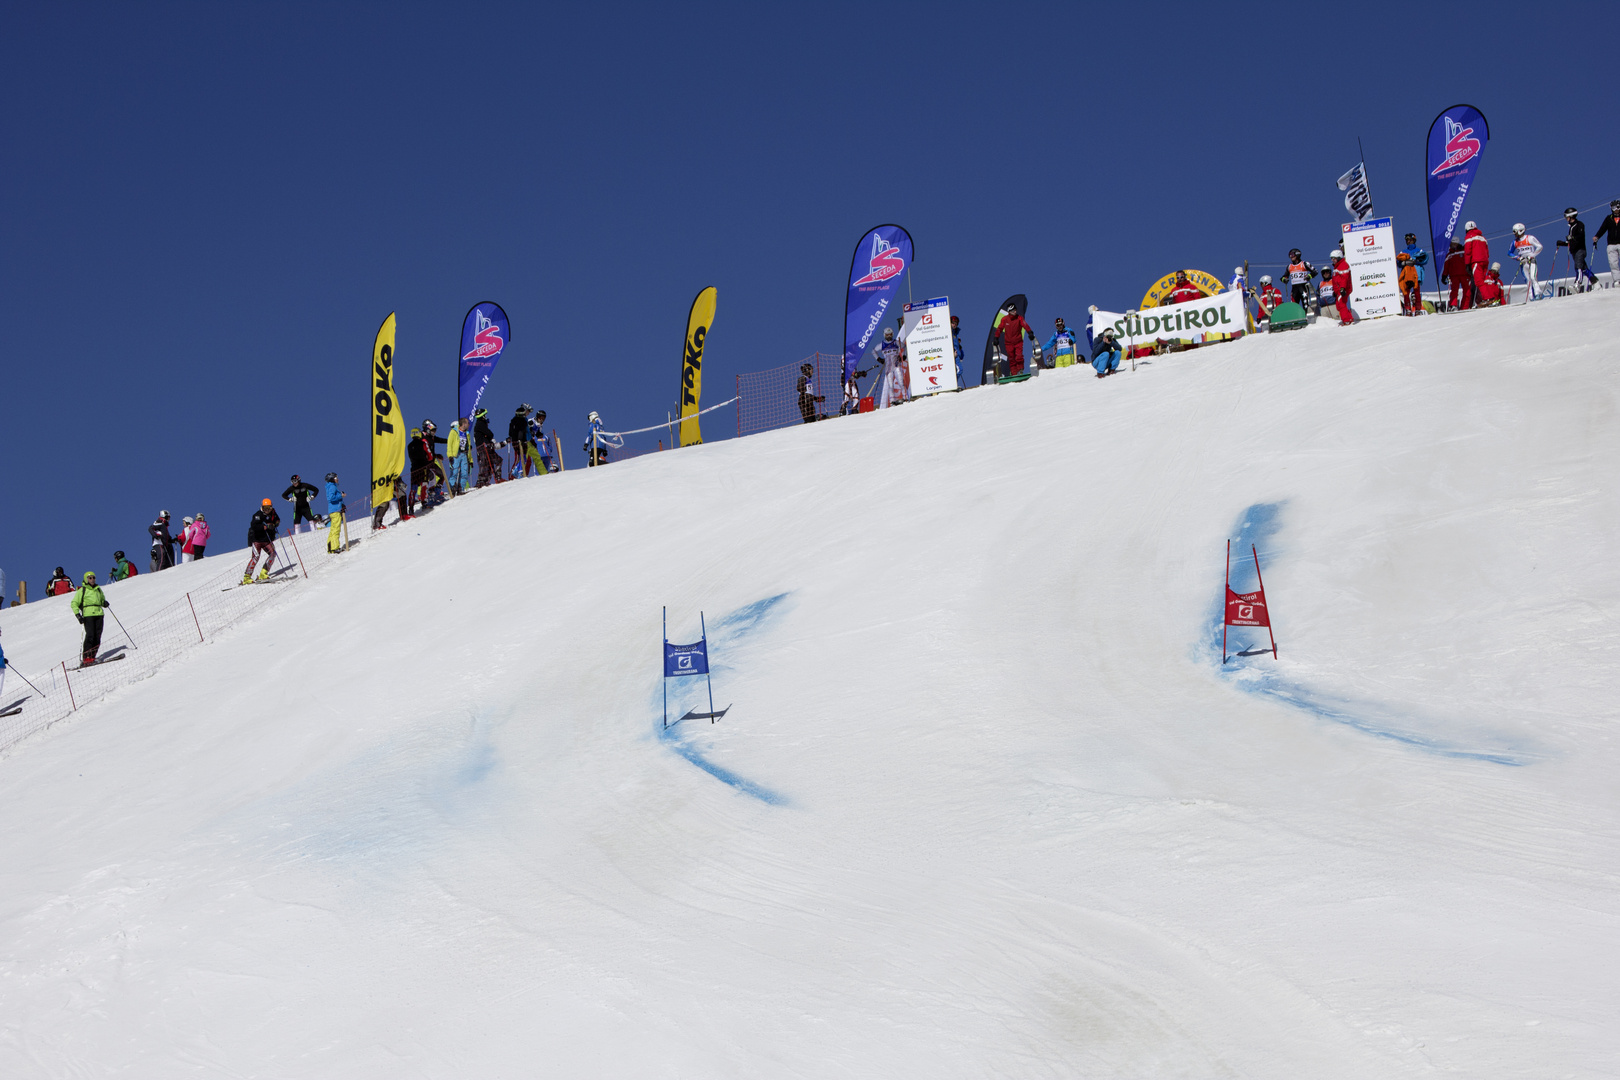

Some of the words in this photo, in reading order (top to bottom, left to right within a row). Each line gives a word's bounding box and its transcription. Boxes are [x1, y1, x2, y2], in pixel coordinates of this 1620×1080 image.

[1448, 146, 1472, 166] SECEDA
[1445, 182, 1469, 239] seceda.it
[871, 264, 896, 280] SECEDA
[1160, 273, 1218, 292] CRTINA
[858, 298, 889, 349] seceda.it
[476, 342, 497, 356] SECEDA
[683, 325, 706, 407] TOKO
[375, 343, 394, 437] TOKO
